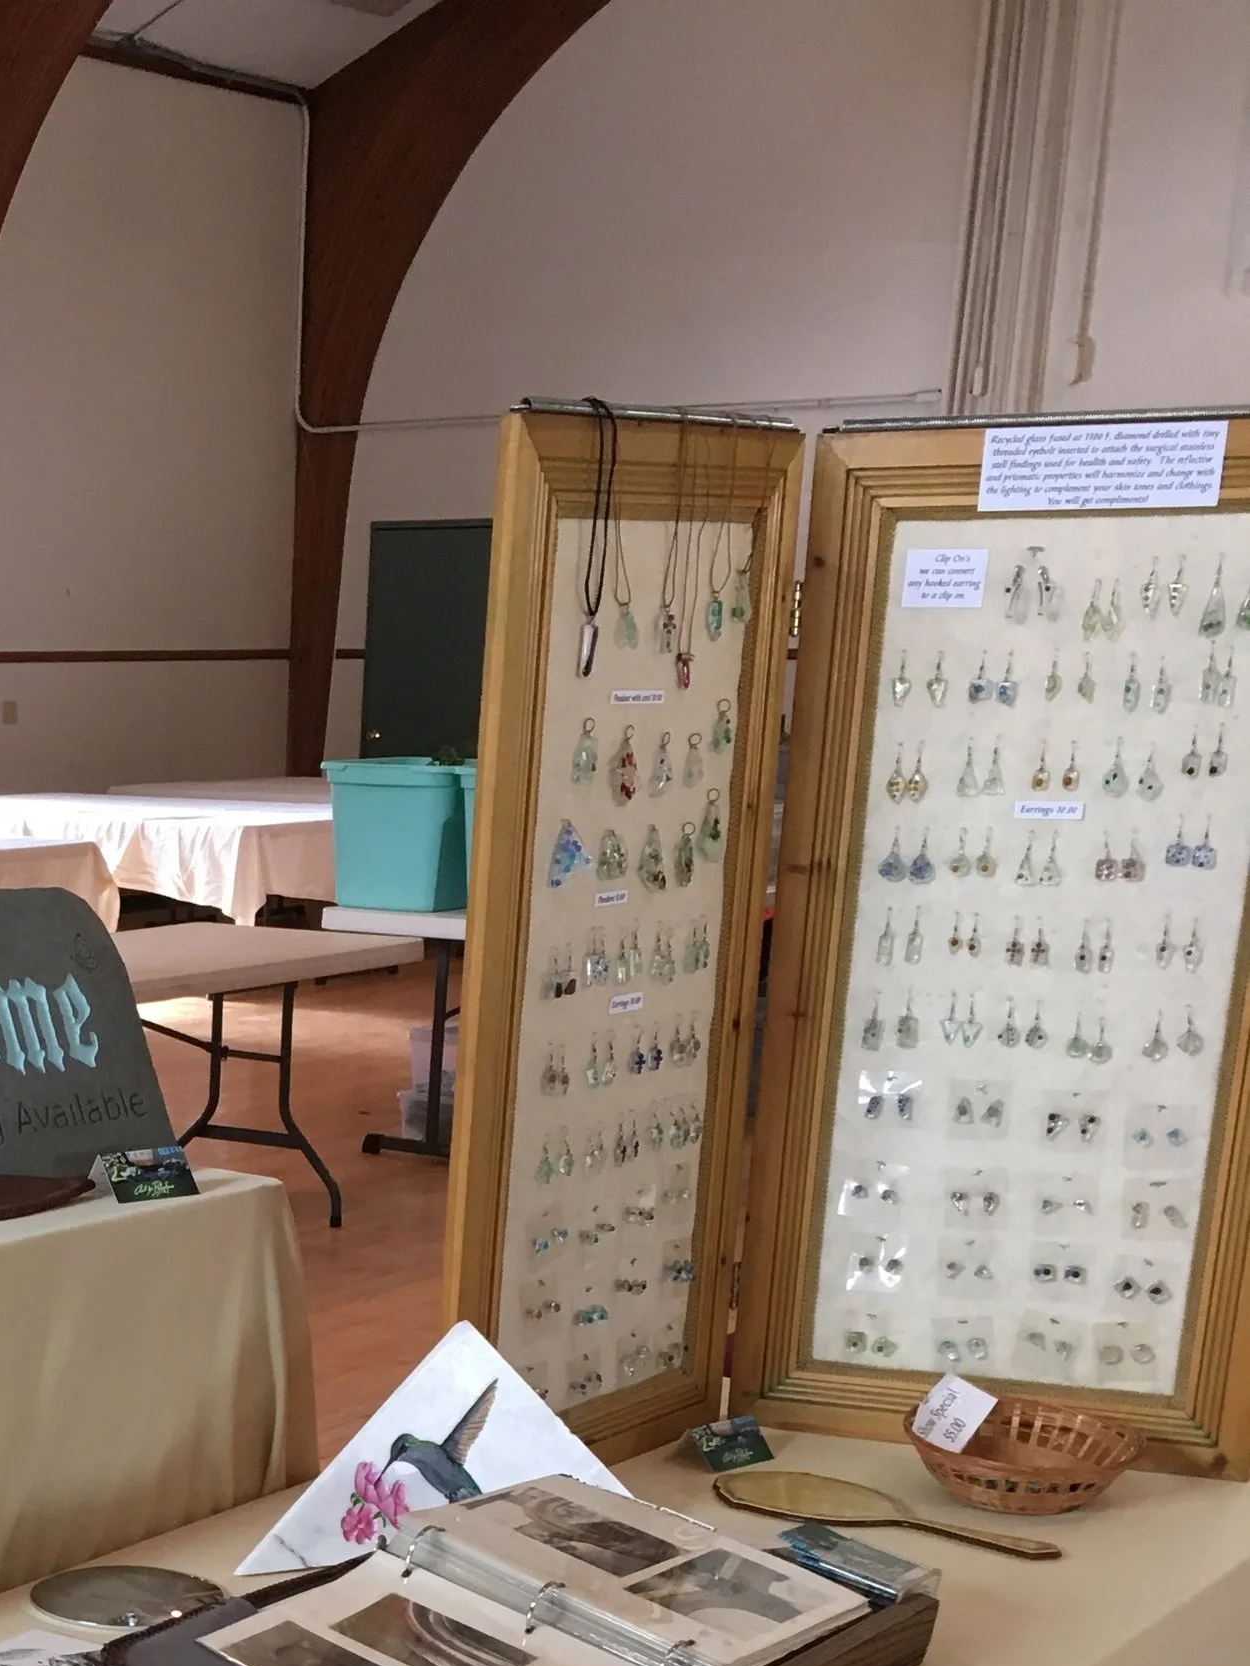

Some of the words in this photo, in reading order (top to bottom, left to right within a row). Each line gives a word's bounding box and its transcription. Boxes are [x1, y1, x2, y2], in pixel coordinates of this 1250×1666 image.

[991, 434, 1025, 444] Recycled
[1025, 434, 1046, 446] glass
[1048, 432, 1072, 444] fused
[1114, 429, 1152, 440] diamond
[1181, 429, 1200, 437] with
[1202, 430, 1220, 439] tiny
[993, 446, 1028, 456] threaded
[1058, 445, 1089, 454] inserted
[1102, 444, 1128, 453] attach
[1130, 444, 1142, 452] the
[1145, 442, 1178, 456] surgical
[1180, 442, 1214, 451] stainless
[1009, 460, 1042, 472] findings
[1044, 458, 1064, 468] used
[1108, 457, 1126, 466] and
[1160, 456, 1174, 464] The
[1177, 454, 1213, 466] reflective
[986, 473, 1002, 481] and
[1003, 473, 1041, 483] prismatic
[1043, 471, 1082, 482] properties
[1085, 470, 1101, 478] will
[1102, 470, 1146, 478] harmonize
[1147, 469, 1164, 477] and
[1166, 468, 1194, 480] change
[1196, 468, 1215, 476] with
[986, 486, 998, 494] the
[1000, 485, 1032, 497] lighting
[1044, 484, 1090, 495] complement
[1092, 485, 1111, 496] your
[1114, 482, 1130, 490] skin
[1156, 482, 1174, 490] and
[1047, 496, 1061, 504] You
[1064, 496, 1080, 504] will
[1080, 496, 1093, 508] get
[935, 554, 950, 566] Clip
[908, 580, 922, 589] any
[924, 578, 952, 586] hooked
[952, 580, 981, 590] earring
[938, 590, 953, 602] clip
[1020, 804, 1054, 816] Earrings
[16, 1090, 148, 1134] Available
[930, 1387, 960, 1420] Special
[943, 1417, 966, 1442] $5.00
